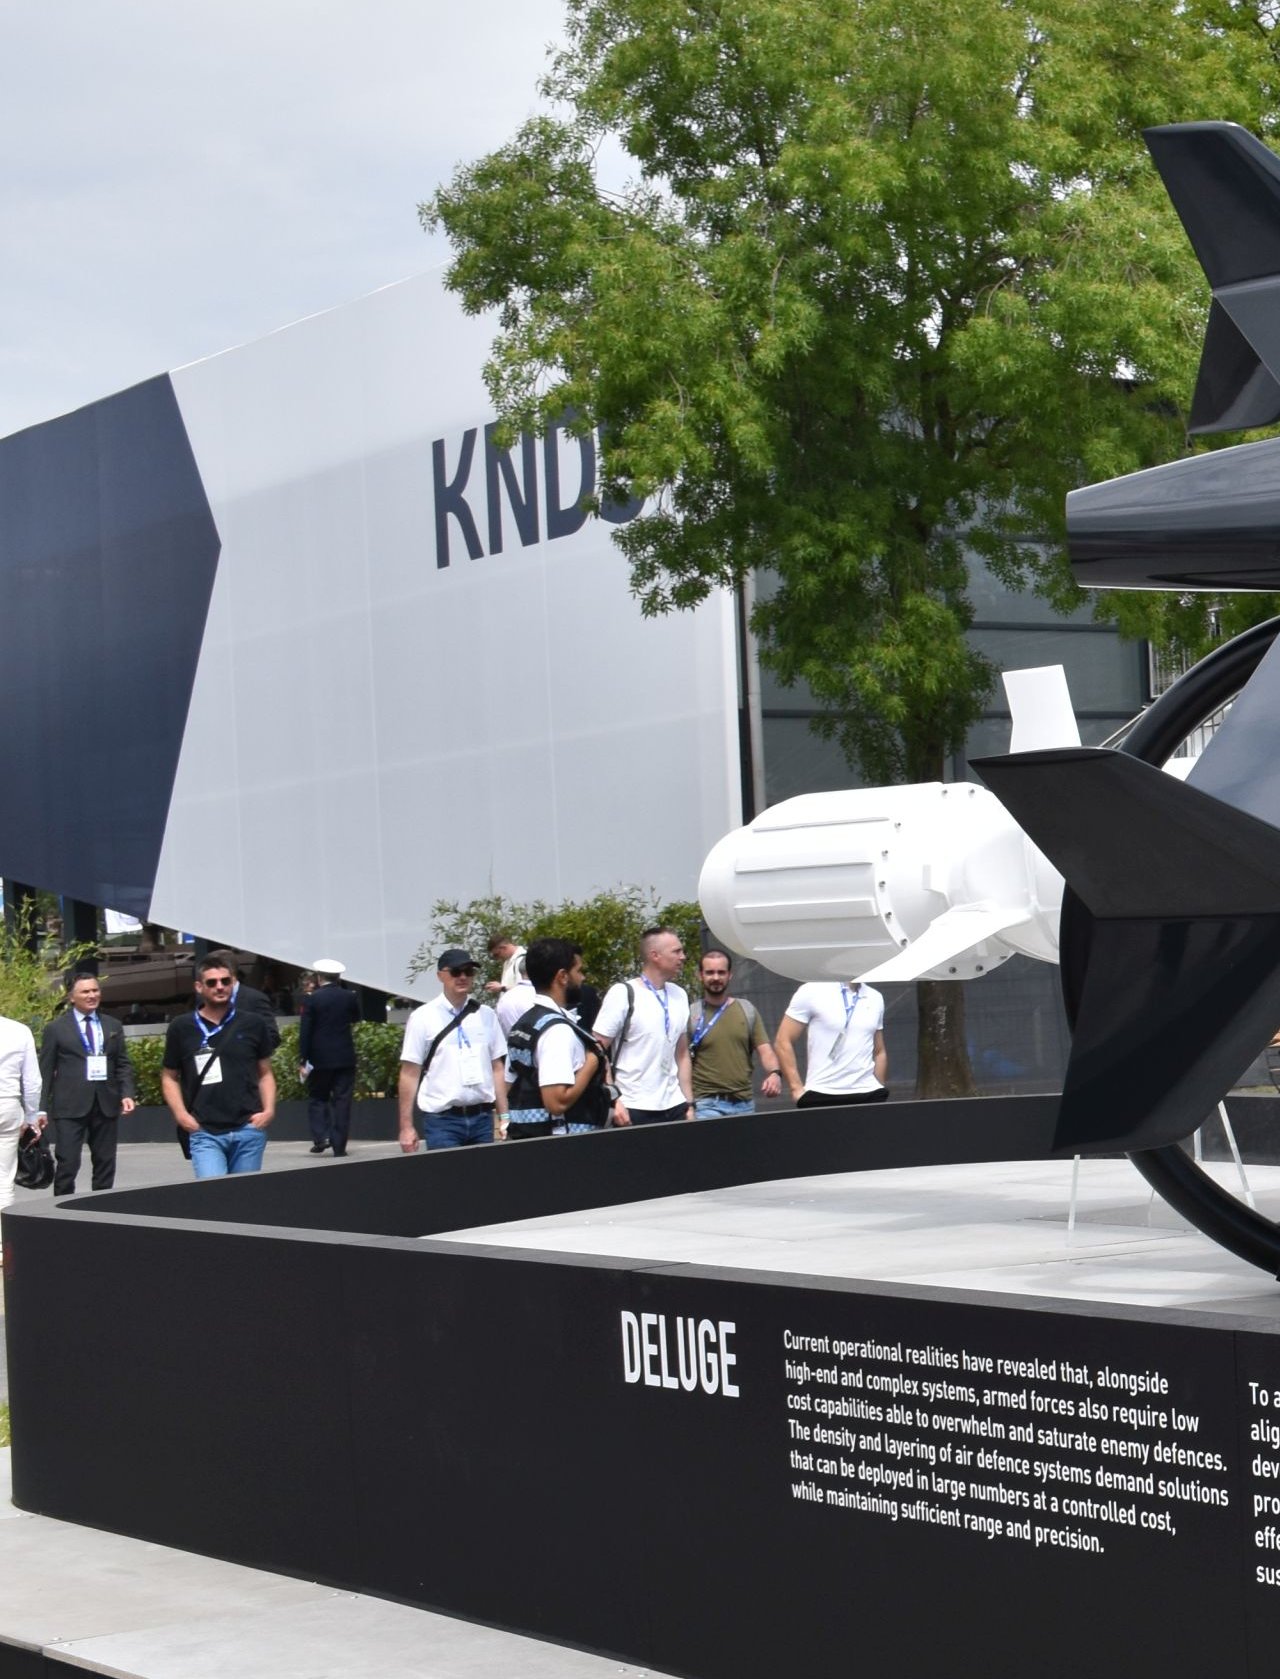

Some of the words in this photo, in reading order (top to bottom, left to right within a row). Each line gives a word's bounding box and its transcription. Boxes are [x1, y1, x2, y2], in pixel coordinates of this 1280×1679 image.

[432, 402, 650, 569] KND
[620, 1310, 740, 1398] DELUGE
[783, 1329, 830, 1354] Current
[832, 1339, 904, 1363] operational
[905, 1345, 960, 1369] realities
[962, 1349, 994, 1374] have
[997, 1357, 1057, 1381] revealed
[1060, 1361, 1094, 1389] that,
[1097, 1365, 1169, 1397] alongside
[785, 1359, 838, 1386] high-end
[840, 1368, 864, 1388] and
[866, 1373, 920, 1398] complex
[921, 1380, 980, 1407] systems,
[983, 1388, 1027, 1410] armed
[1030, 1389, 1075, 1417] forces
[1078, 1397, 1109, 1421] also
[1112, 1404, 1168, 1431] require
[1171, 1407, 1199, 1433] low
[787, 1393, 812, 1411] cost
[814, 1396, 884, 1422] capabilities
[886, 1403, 913, 1426] able
[915, 1408, 929, 1428] to
[932, 1414, 1006, 1439] overwhelm
[1008, 1422, 1034, 1444] and
[1037, 1427, 1097, 1453] saturate
[1100, 1438, 1150, 1466] enemy
[1153, 1440, 1228, 1472] defences.
[1248, 1381, 1269, 1407] To
[787, 1418, 811, 1441] The
[813, 1423, 857, 1453] density
[859, 1432, 882, 1452] and
[884, 1433, 937, 1466] layering
[939, 1442, 952, 1463] of
[955, 1444, 974, 1466] air
[976, 1447, 1030, 1476] defence
[1033, 1460, 1092, 1485] systems
[1095, 1465, 1154, 1495] demand
[1158, 1476, 1229, 1507] solutions
[789, 1449, 814, 1471] that
[816, 1458, 838, 1475] can
[840, 1456, 856, 1478] be
[857, 1460, 914, 1490] deployed
[916, 1469, 929, 1491] in
[931, 1471, 967, 1501] large
[969, 1482, 1030, 1508] numbers
[1033, 1490, 1048, 1511] at
[1050, 1496, 1059, 1513] a
[1062, 1498, 1137, 1526] controlled
[1140, 1510, 1176, 1536] cost,
[791, 1480, 824, 1503] while
[826, 1487, 899, 1522] maintaining
[900, 1500, 961, 1528] sufficient
[963, 1513, 1003, 1540] range
[1006, 1519, 1031, 1541] and
[1034, 1525, 1105, 1553] precision.
